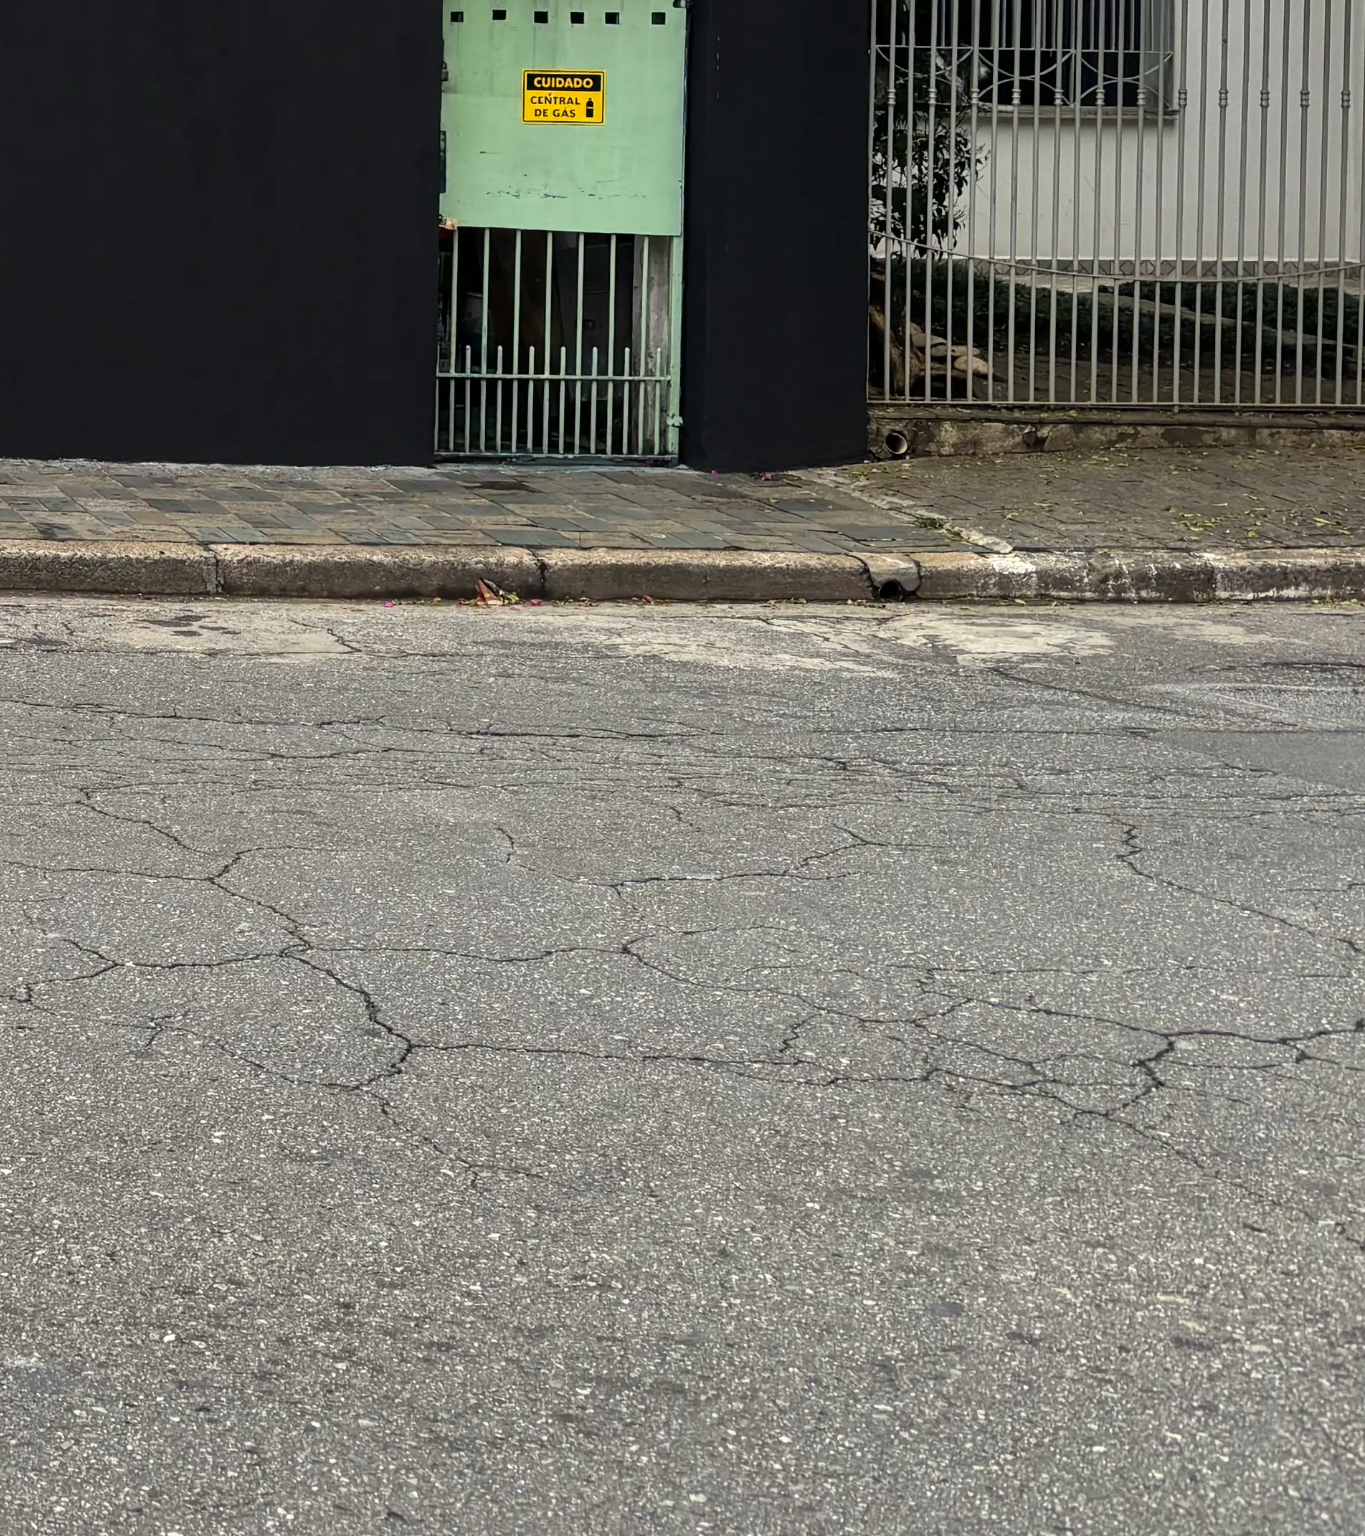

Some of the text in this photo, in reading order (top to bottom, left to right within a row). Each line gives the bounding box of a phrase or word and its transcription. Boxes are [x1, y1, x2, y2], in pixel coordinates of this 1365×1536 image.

[533, 76, 594, 89] CUIDADO
[530, 95, 581, 106] CENTRAL
[534, 107, 576, 117] DE GÁS
